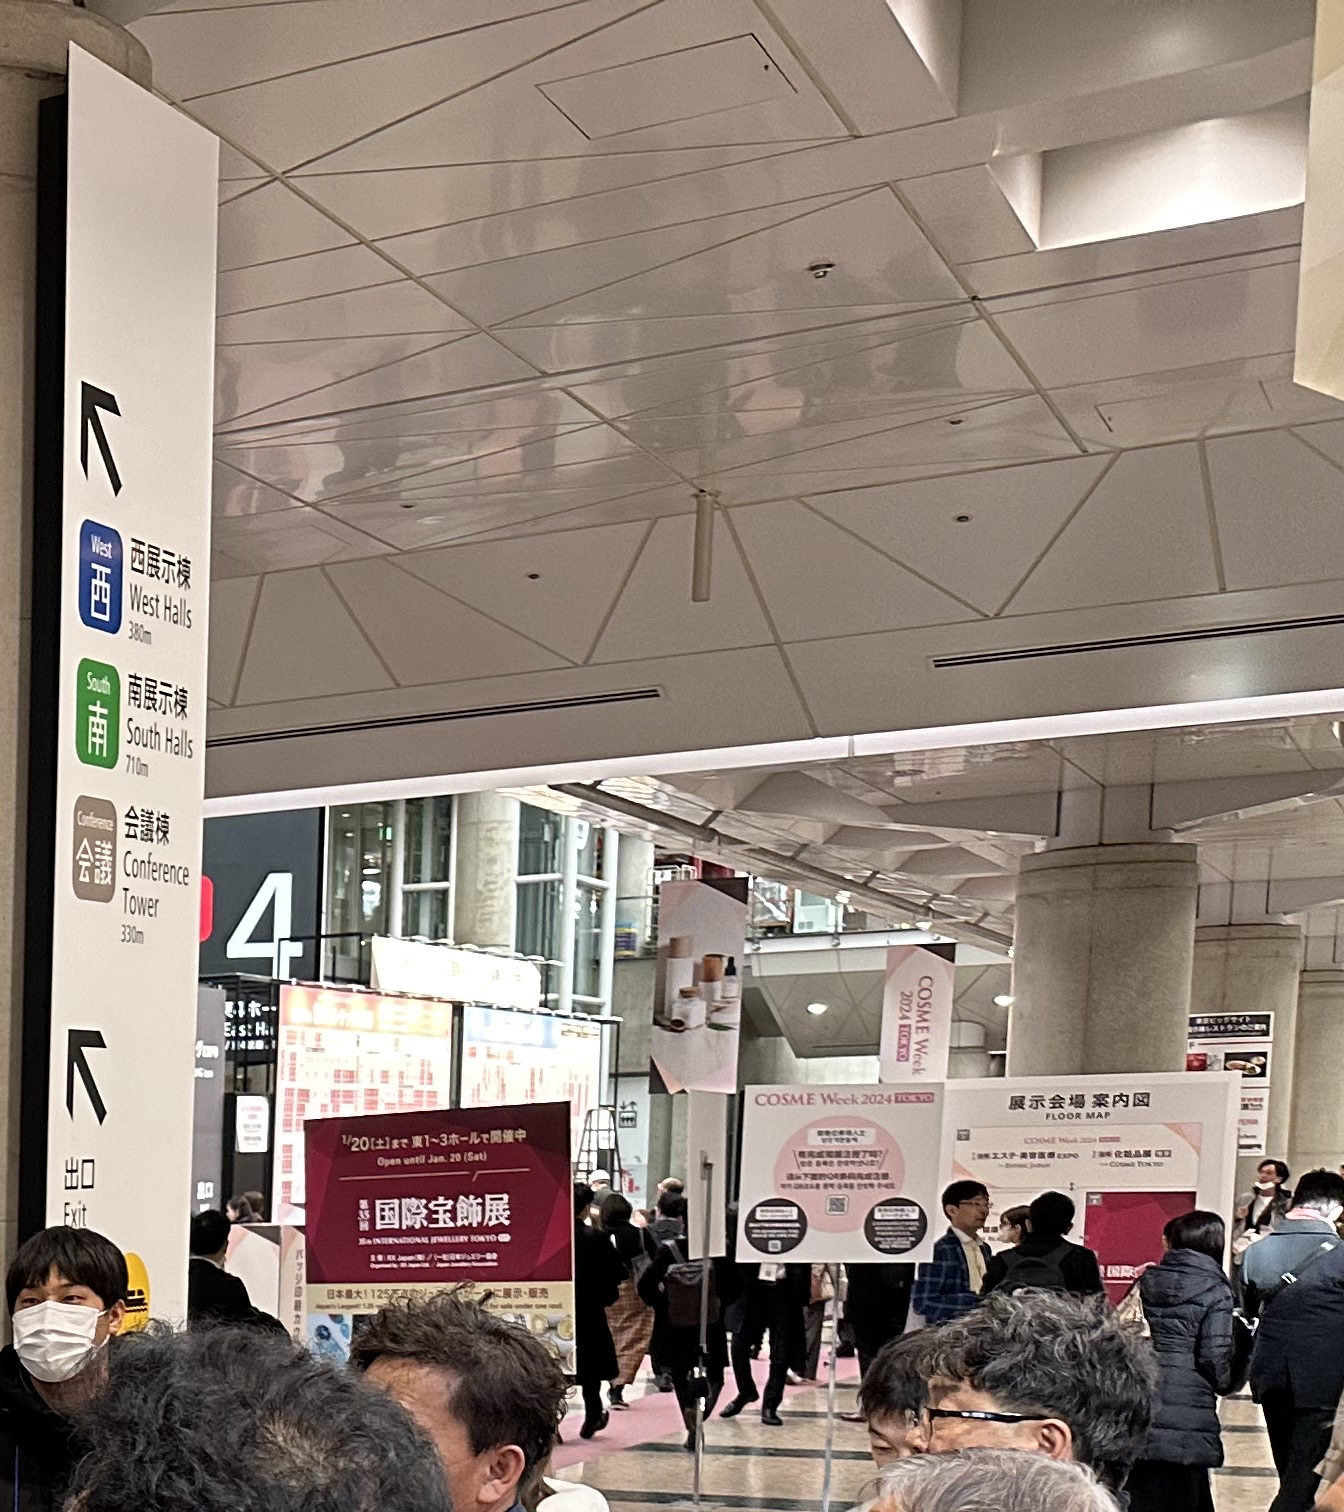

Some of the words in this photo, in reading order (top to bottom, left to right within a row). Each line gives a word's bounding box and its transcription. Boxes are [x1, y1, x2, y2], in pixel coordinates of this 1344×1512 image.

[90, 534, 112, 559] West
[130, 537, 192, 591] 西展示棟
[90, 562, 112, 622] 西
[129, 583, 160, 619] West
[164, 591, 193, 629] Halls
[128, 620, 152, 645] 380m
[86, 672, 111, 696] South
[127, 673, 189, 721] 南展示棟
[87, 700, 109, 758] 南
[126, 718, 161, 752] South
[165, 726, 194, 760] Halls
[125, 754, 149, 778] 710m
[124, 805, 170, 846] 会議棟
[76, 838, 113, 886] 会議
[123, 850, 190, 887] Conference
[122, 887, 160, 919] Tower
[121, 924, 145, 945] 330m
[226, 871, 303, 978] 4
[898, 990, 913, 1021] 2024
[915, 975, 934, 1035] COSME
[912, 1038, 929, 1077] Week
[754, 1092, 816, 1107] COSME
[819, 1092, 860, 1106] Week
[861, 1093, 893, 1105] 2024
[1008, 1094, 1086, 1110] 展示会場
[1091, 1092, 1151, 1109] 案内図
[1045, 1112, 1082, 1121] FLOOR
[1085, 1111, 1111, 1120] MAP
[64, 1156, 95, 1190] 出口
[377, 1156, 402, 1168] Open
[403, 1154, 426, 1166] until
[427, 1152, 448, 1164] Jan.
[449, 1152, 462, 1163] 20
[463, 1150, 488, 1163] (Sat)
[63, 1200, 87, 1228] Exit
[374, 1193, 511, 1231] 国際宝飾展
